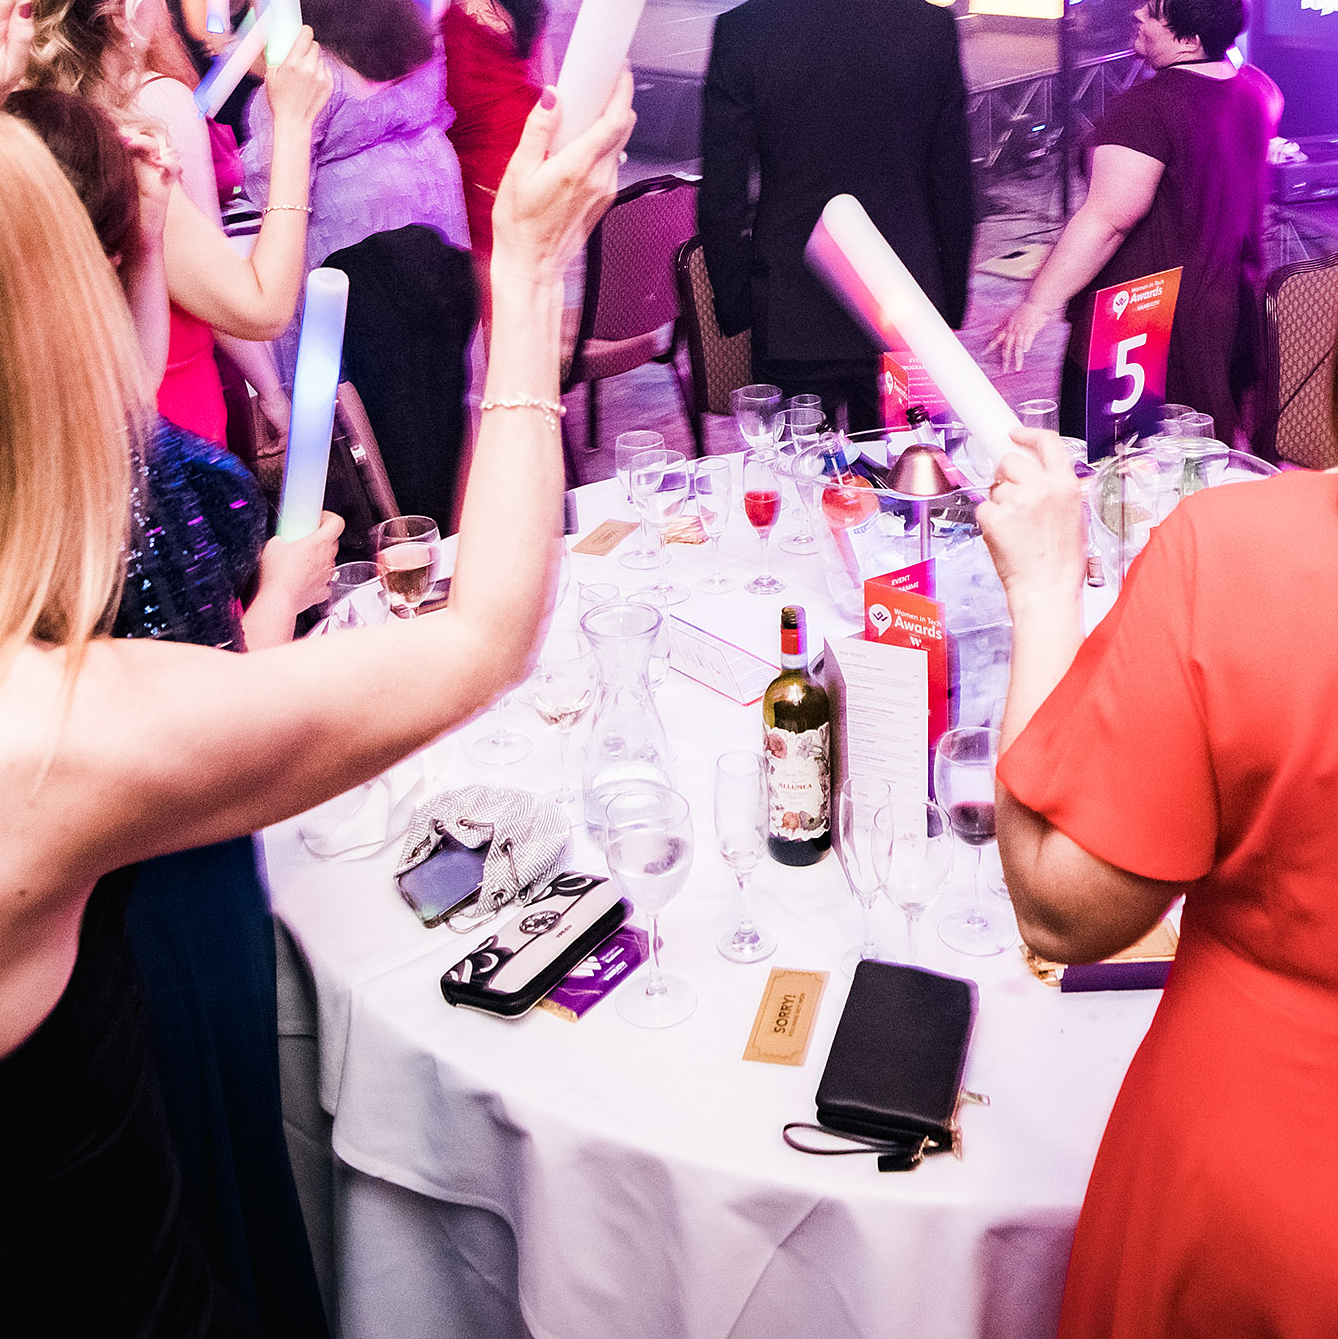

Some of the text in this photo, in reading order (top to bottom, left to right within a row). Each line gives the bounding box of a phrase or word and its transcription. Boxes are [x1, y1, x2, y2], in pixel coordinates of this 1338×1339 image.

[1129, 285, 1163, 304] Awards
[1111, 333, 1148, 414] 5
[891, 574, 911, 586] EVENT
[893, 607, 942, 628] Women in Tech
[894, 616, 942, 640] Awards
[774, 994, 796, 1033] SORRY!
